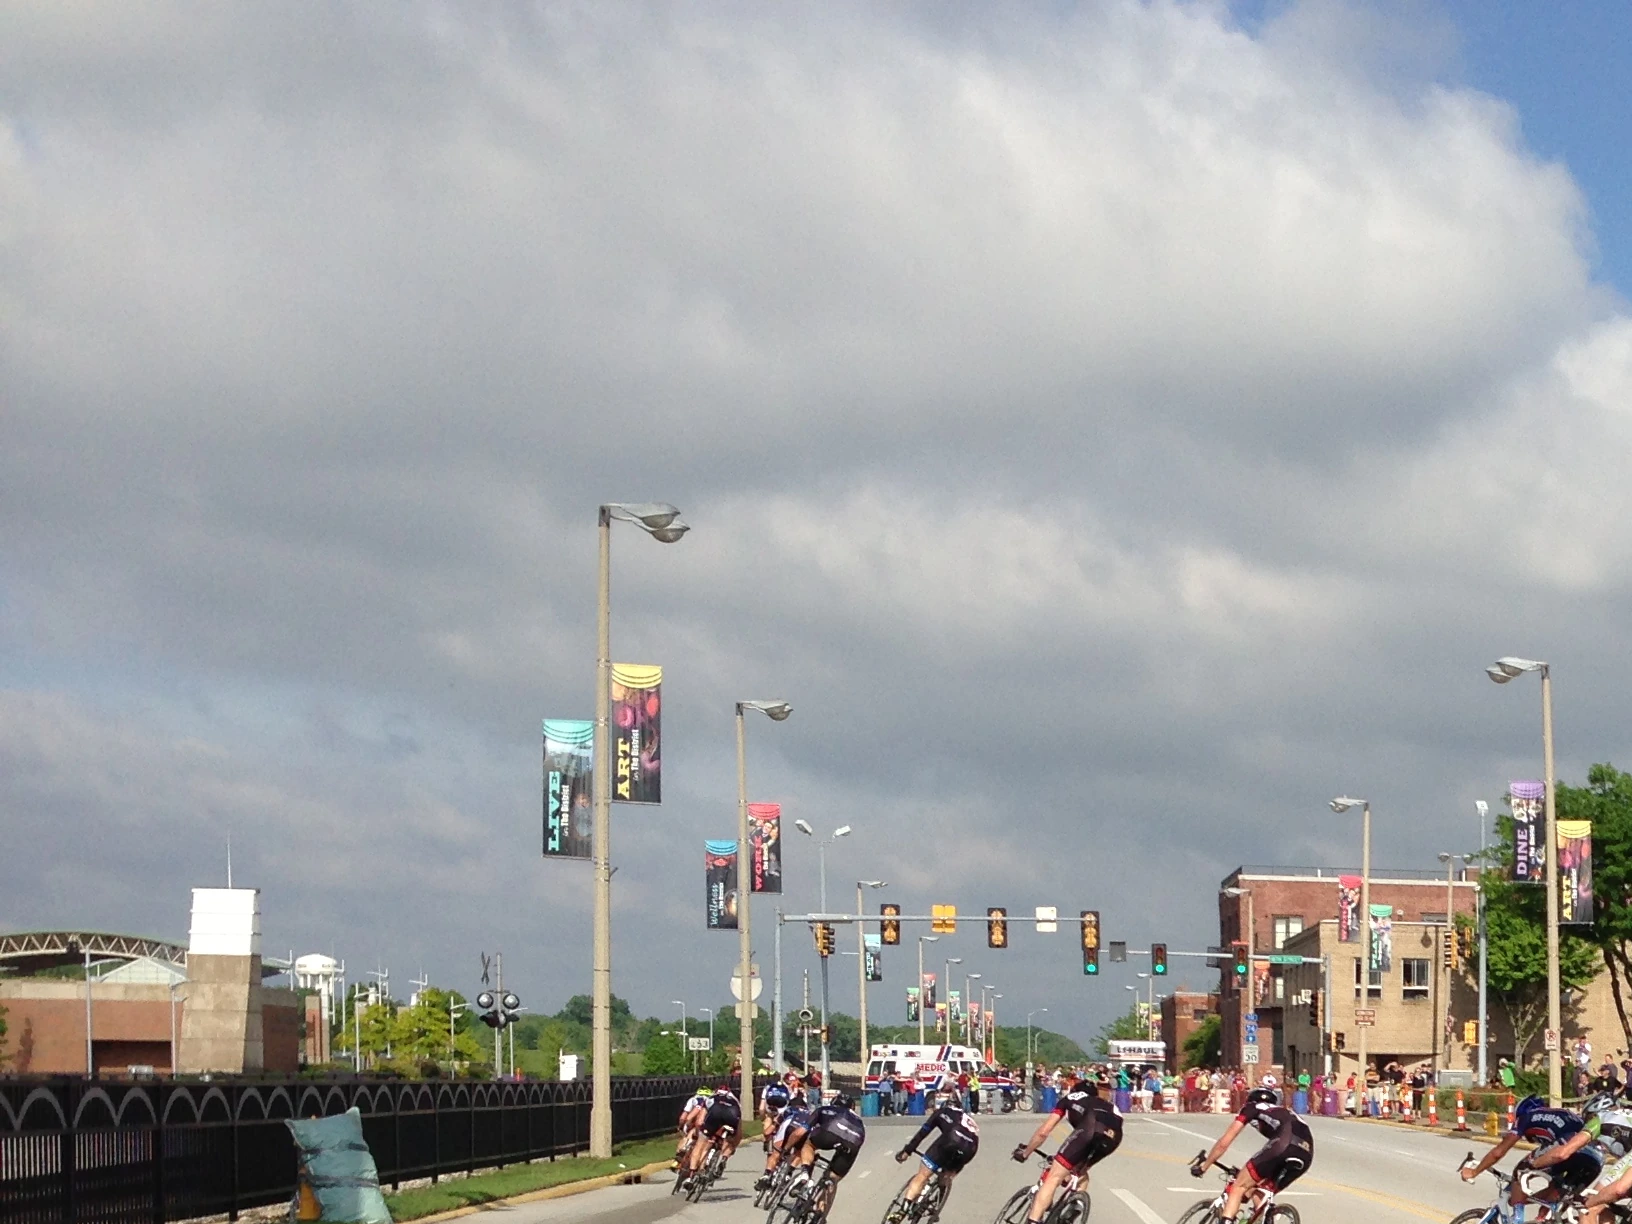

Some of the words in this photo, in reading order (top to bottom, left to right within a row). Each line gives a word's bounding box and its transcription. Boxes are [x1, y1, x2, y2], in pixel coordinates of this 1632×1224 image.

[631, 729, 640, 758] District
[631, 758, 639, 771] The
[617, 737, 630, 799] ART
[548, 771, 560, 851] LIVE
[560, 814, 569, 826] The
[561, 784, 570, 814] District
[755, 835, 763, 891] WORK
[1517, 828, 1528, 876] DINE
[710, 883, 719, 926] Wellness
[1563, 875, 1572, 921] ART
[916, 1063, 947, 1072] MEDIC
